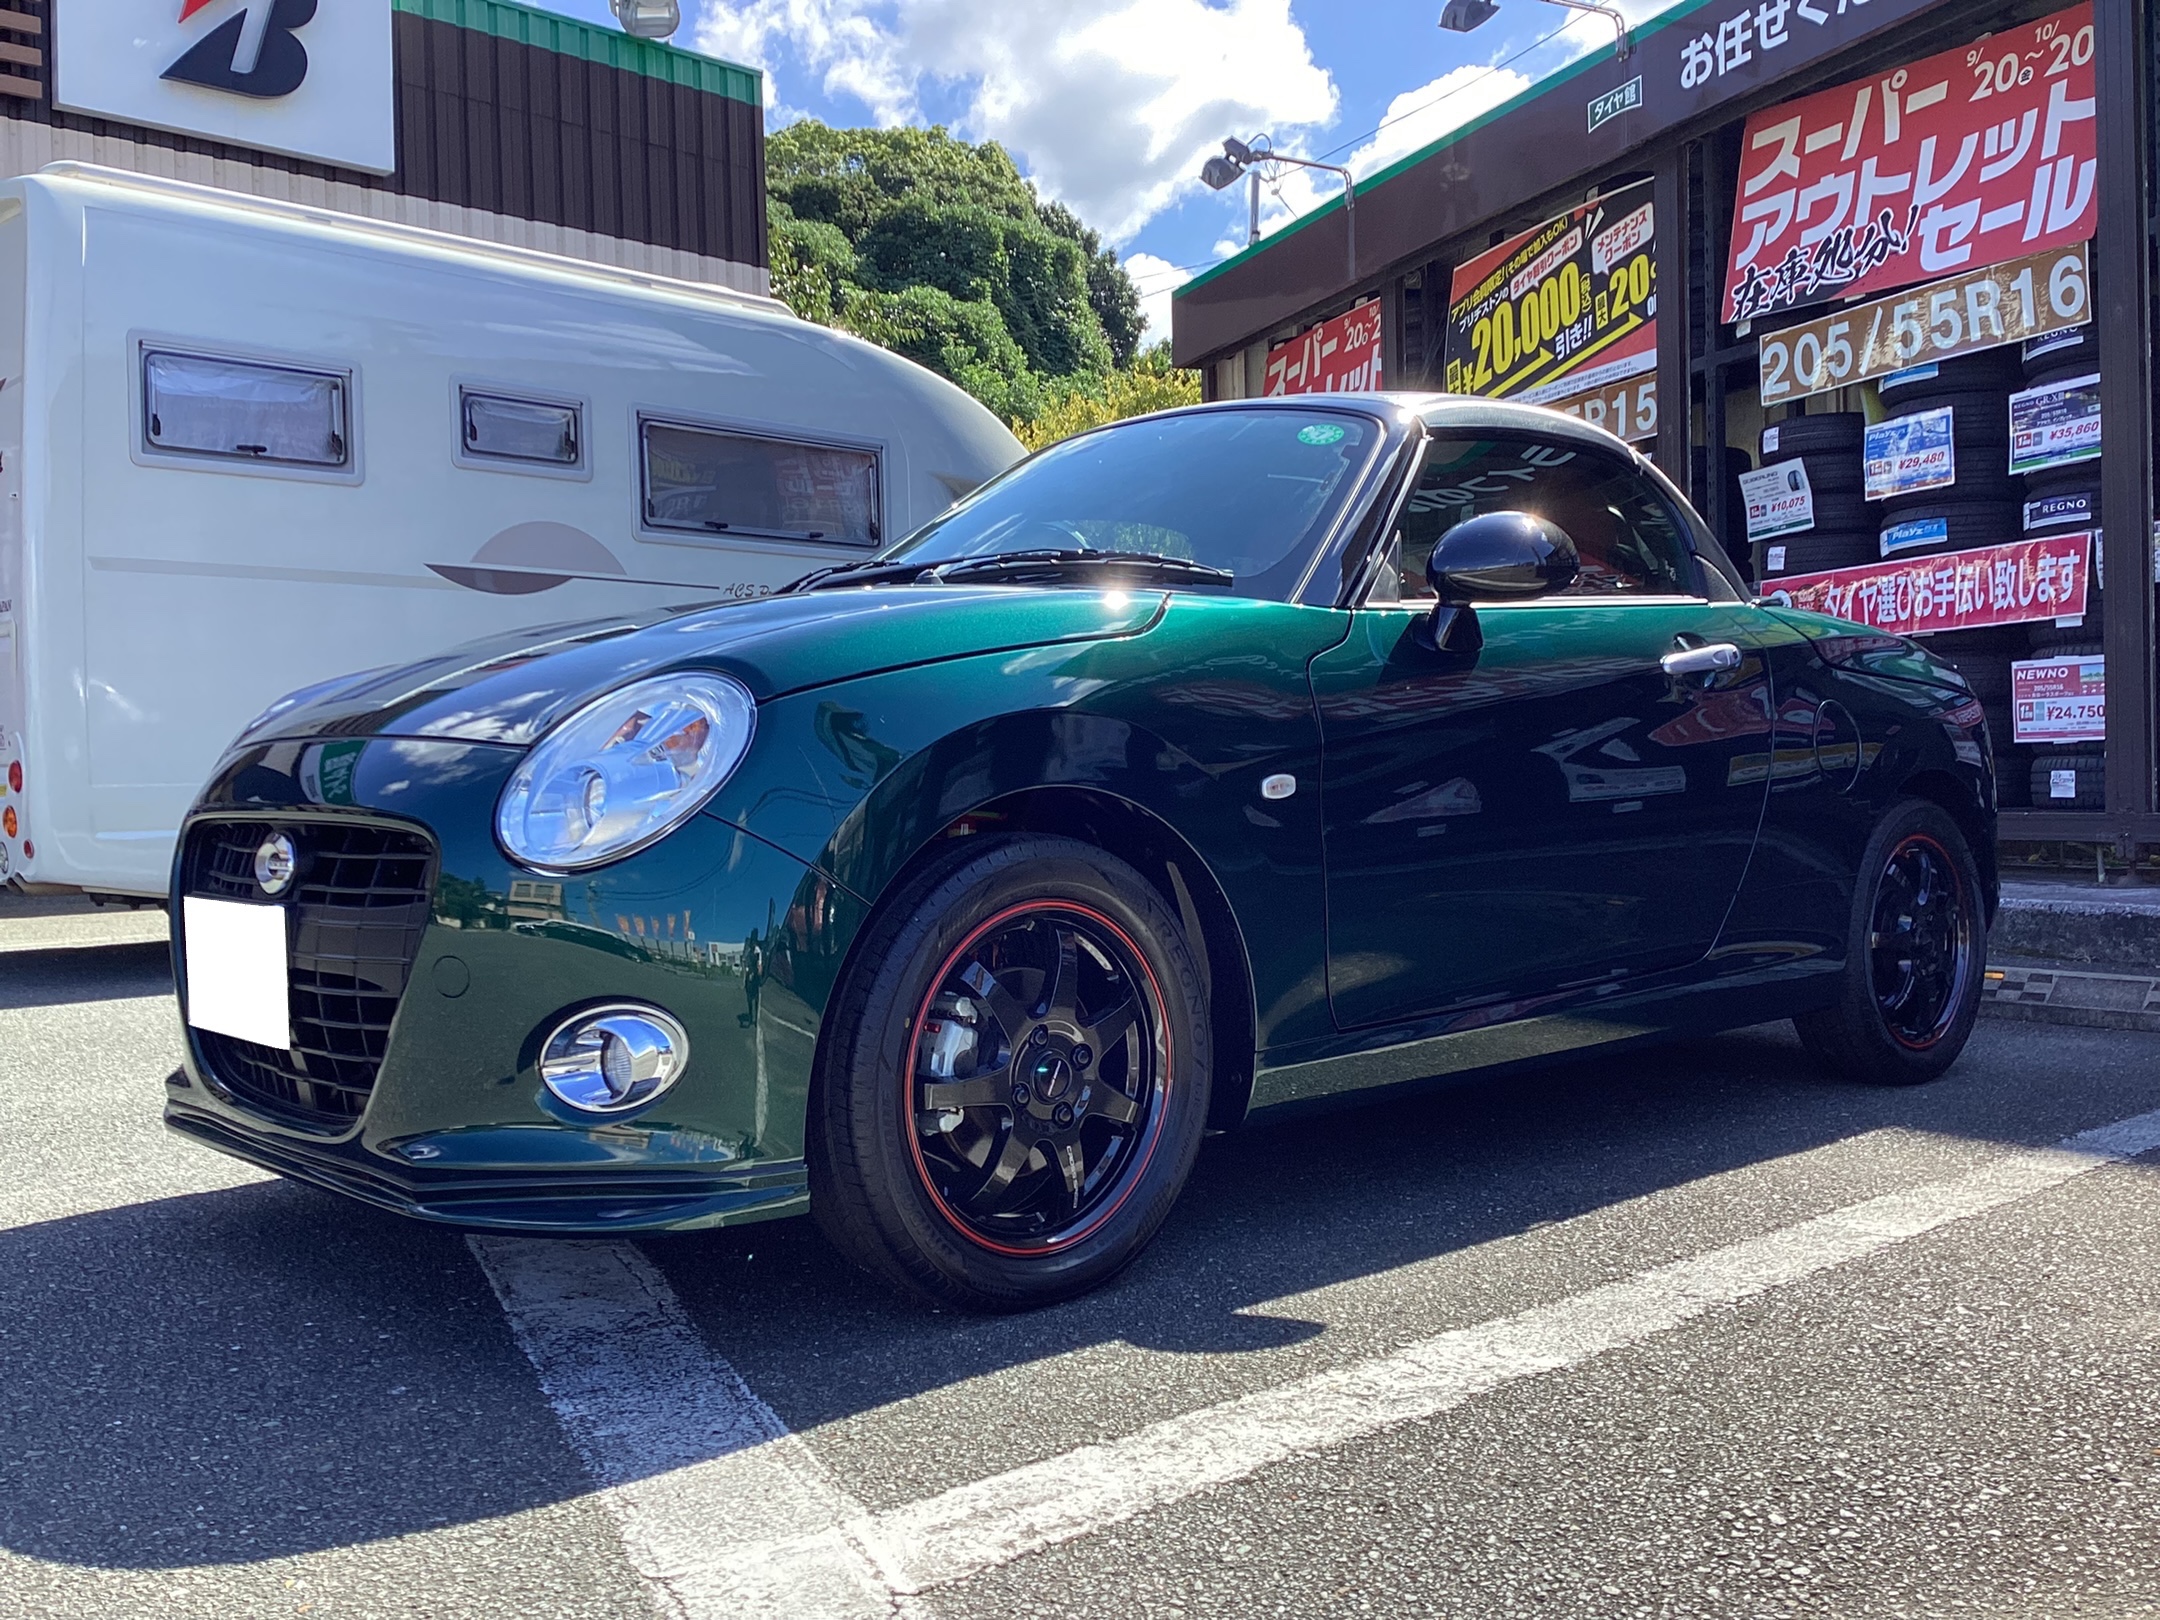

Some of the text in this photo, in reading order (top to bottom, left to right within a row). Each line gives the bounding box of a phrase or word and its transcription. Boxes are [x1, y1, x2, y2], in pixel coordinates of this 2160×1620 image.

[1681, 0, 1871, 89] お任せく
[1594, 83, 1636, 121] タイヤ館
[1745, 69, 1949, 198] スーパー
[1735, 78, 2097, 271] アウトレット
[1597, 209, 1648, 254] メンテナンス
[1919, 155, 2097, 272] セール
[1605, 230, 1640, 264] クーポン
[1761, 254, 2087, 396] 205/55R16
[1268, 327, 1338, 397] スーパー
[2049, 420, 2100, 440] ¥35,860
[1898, 451, 1945, 470] ¥29,480
[1771, 496, 1806, 513] ¥10,075
[2042, 499, 2087, 514] REGNO
[723, 582, 755, 598] ACS
[1824, 548, 2081, 626] タイヤ選びお手伝い致します
[2016, 667, 2069, 680] NEWNO
